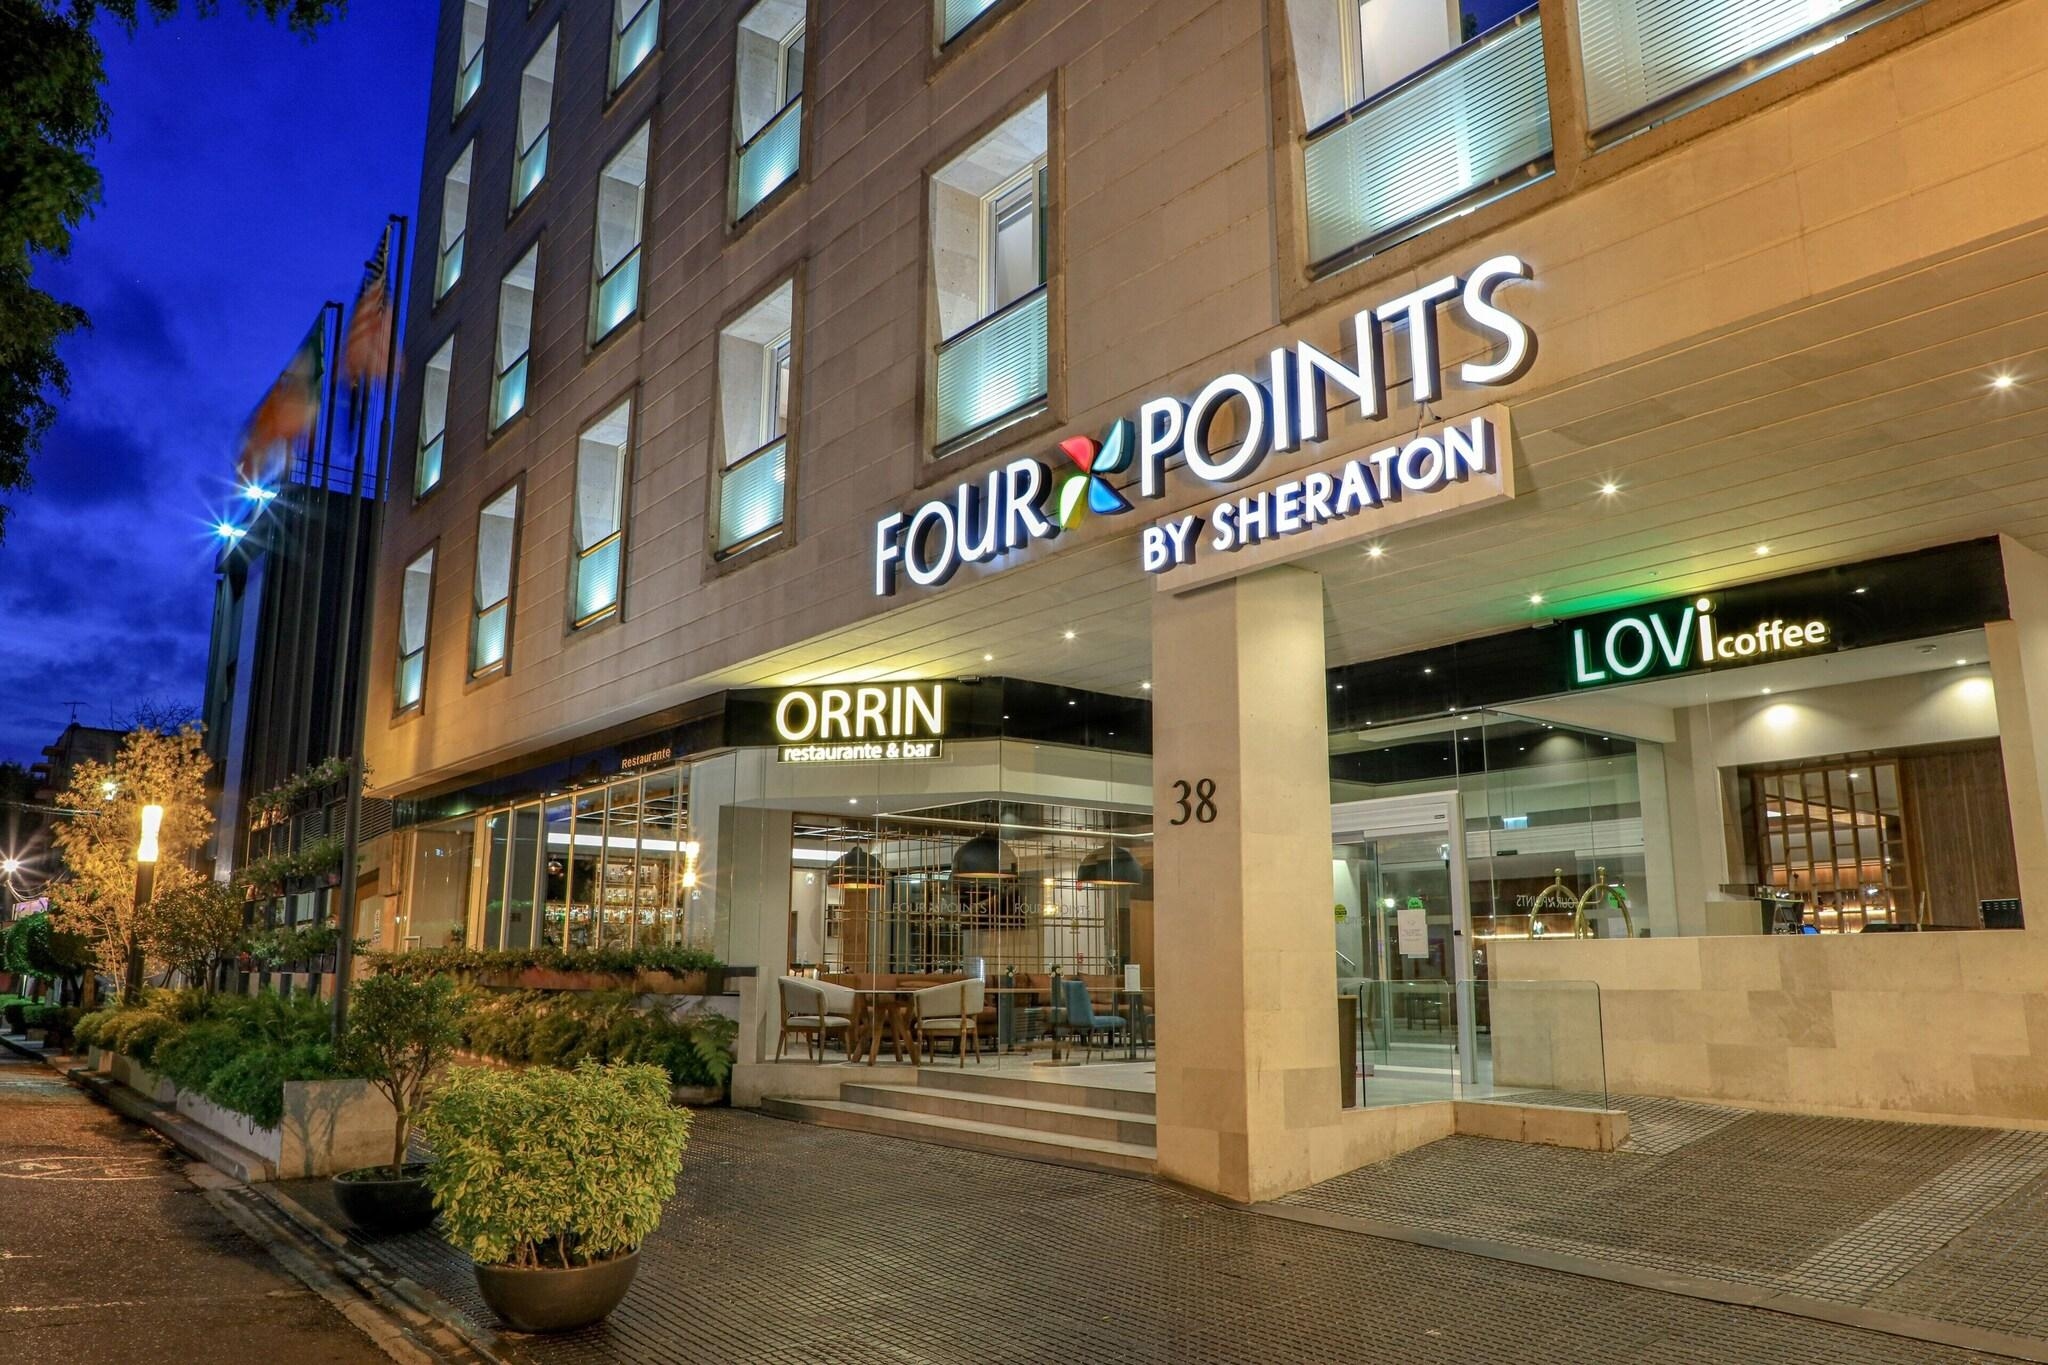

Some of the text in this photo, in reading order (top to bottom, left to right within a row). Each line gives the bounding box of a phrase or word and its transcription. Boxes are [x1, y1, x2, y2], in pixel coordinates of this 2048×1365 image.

[876, 254, 1532, 595] FOUR POINTS
[1142, 416, 1488, 572] BY SHERATON
[1717, 618, 1827, 659] coffee
[775, 684, 943, 741] ORRIN
[621, 747, 671, 769] Restaurante
[784, 741, 934, 761] restaurante & bar
[1170, 778, 1217, 825] 38
